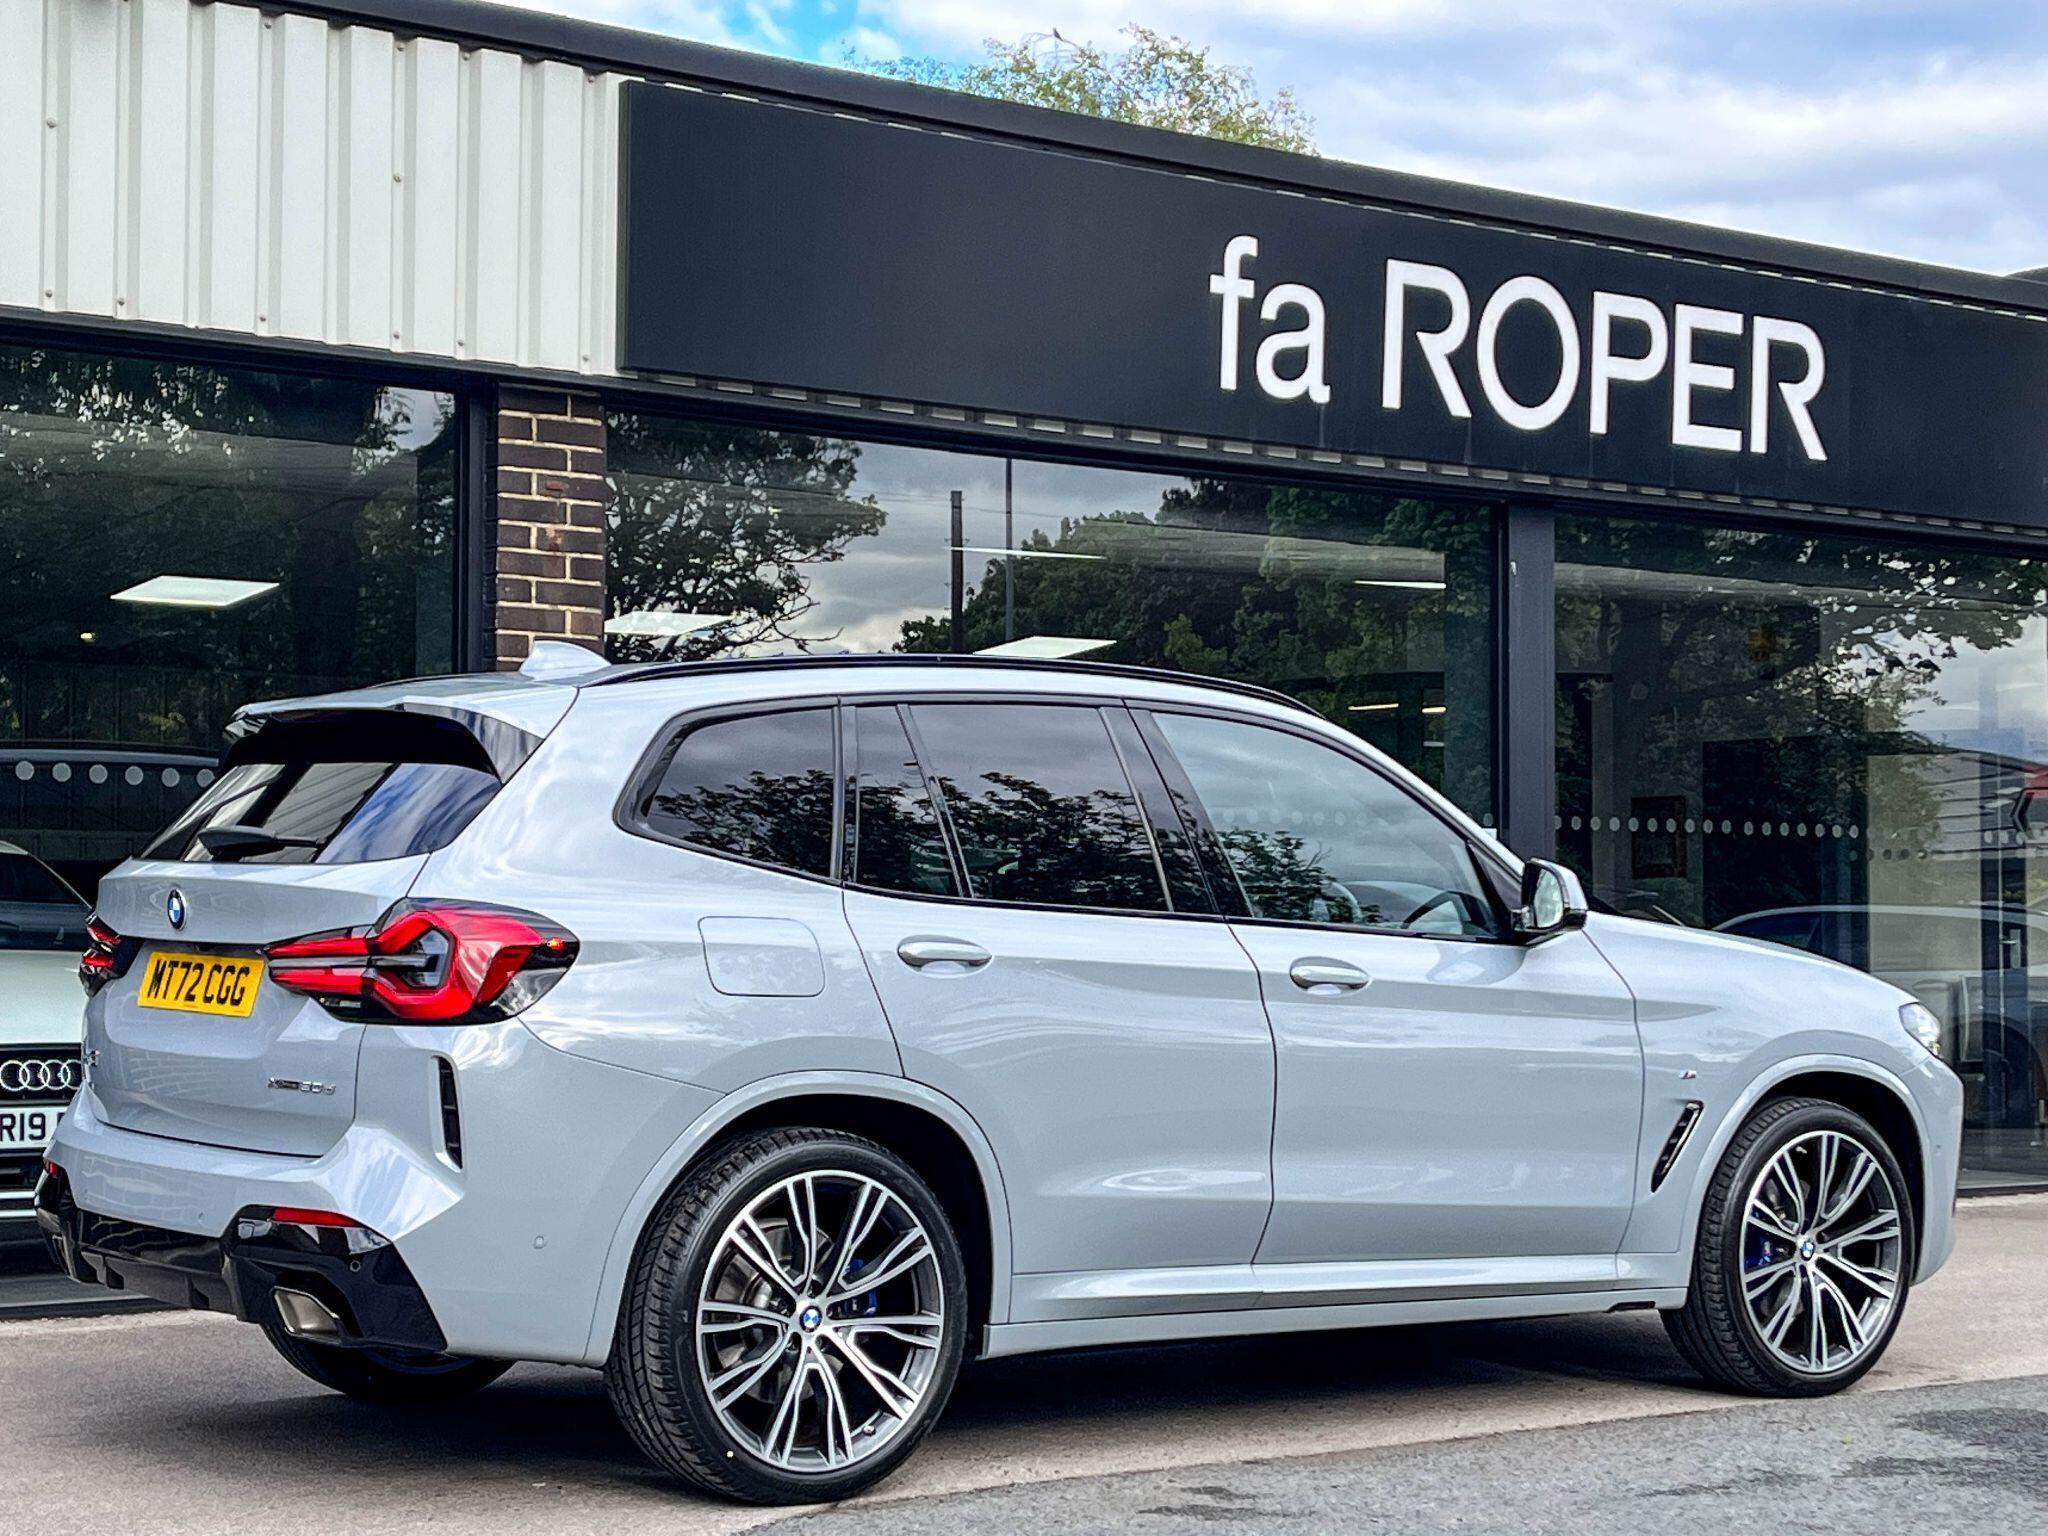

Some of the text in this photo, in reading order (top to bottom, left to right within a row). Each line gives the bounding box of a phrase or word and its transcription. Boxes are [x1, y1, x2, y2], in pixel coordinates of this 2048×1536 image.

[1209, 235, 1827, 461] fa ROPER
[147, 959, 250, 1006] MT72 CGG
